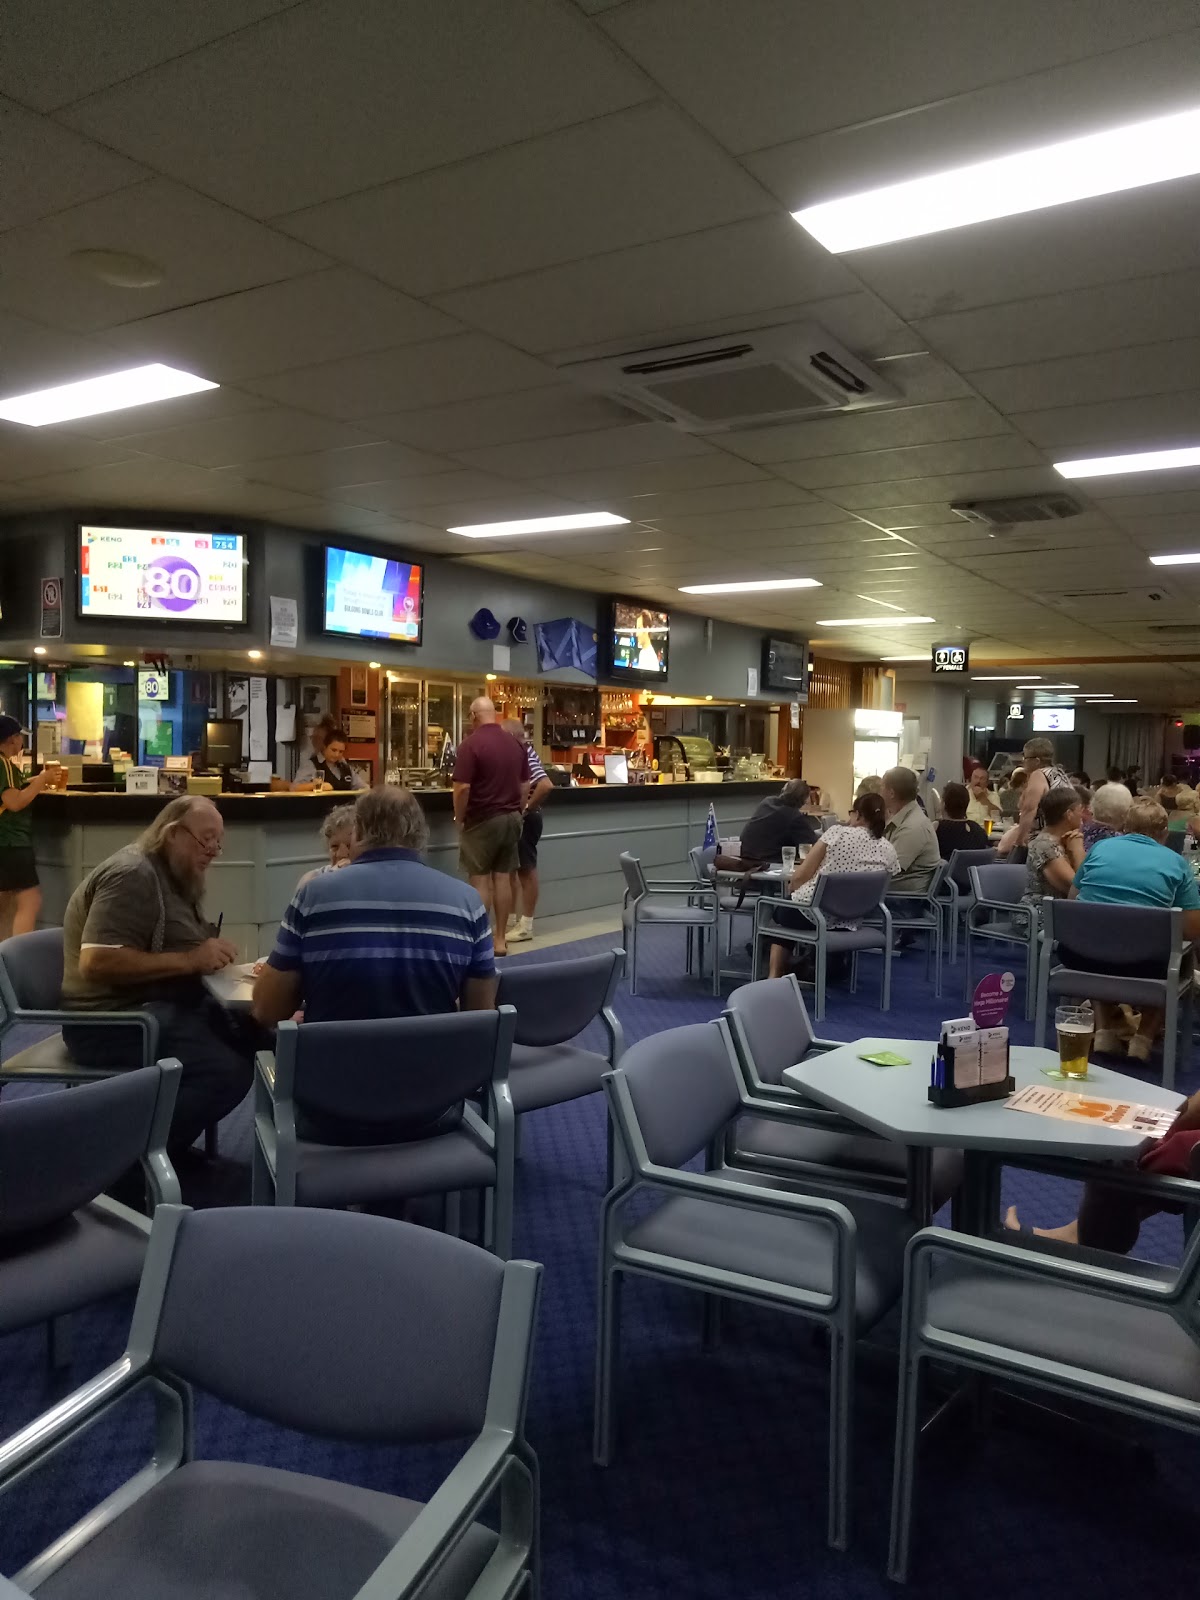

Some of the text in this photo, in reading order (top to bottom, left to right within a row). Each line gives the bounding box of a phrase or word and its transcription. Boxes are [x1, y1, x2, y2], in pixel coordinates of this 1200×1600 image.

[215, 541, 234, 550] 754
[143, 566, 201, 601] 80
[145, 681, 159, 694] 80
